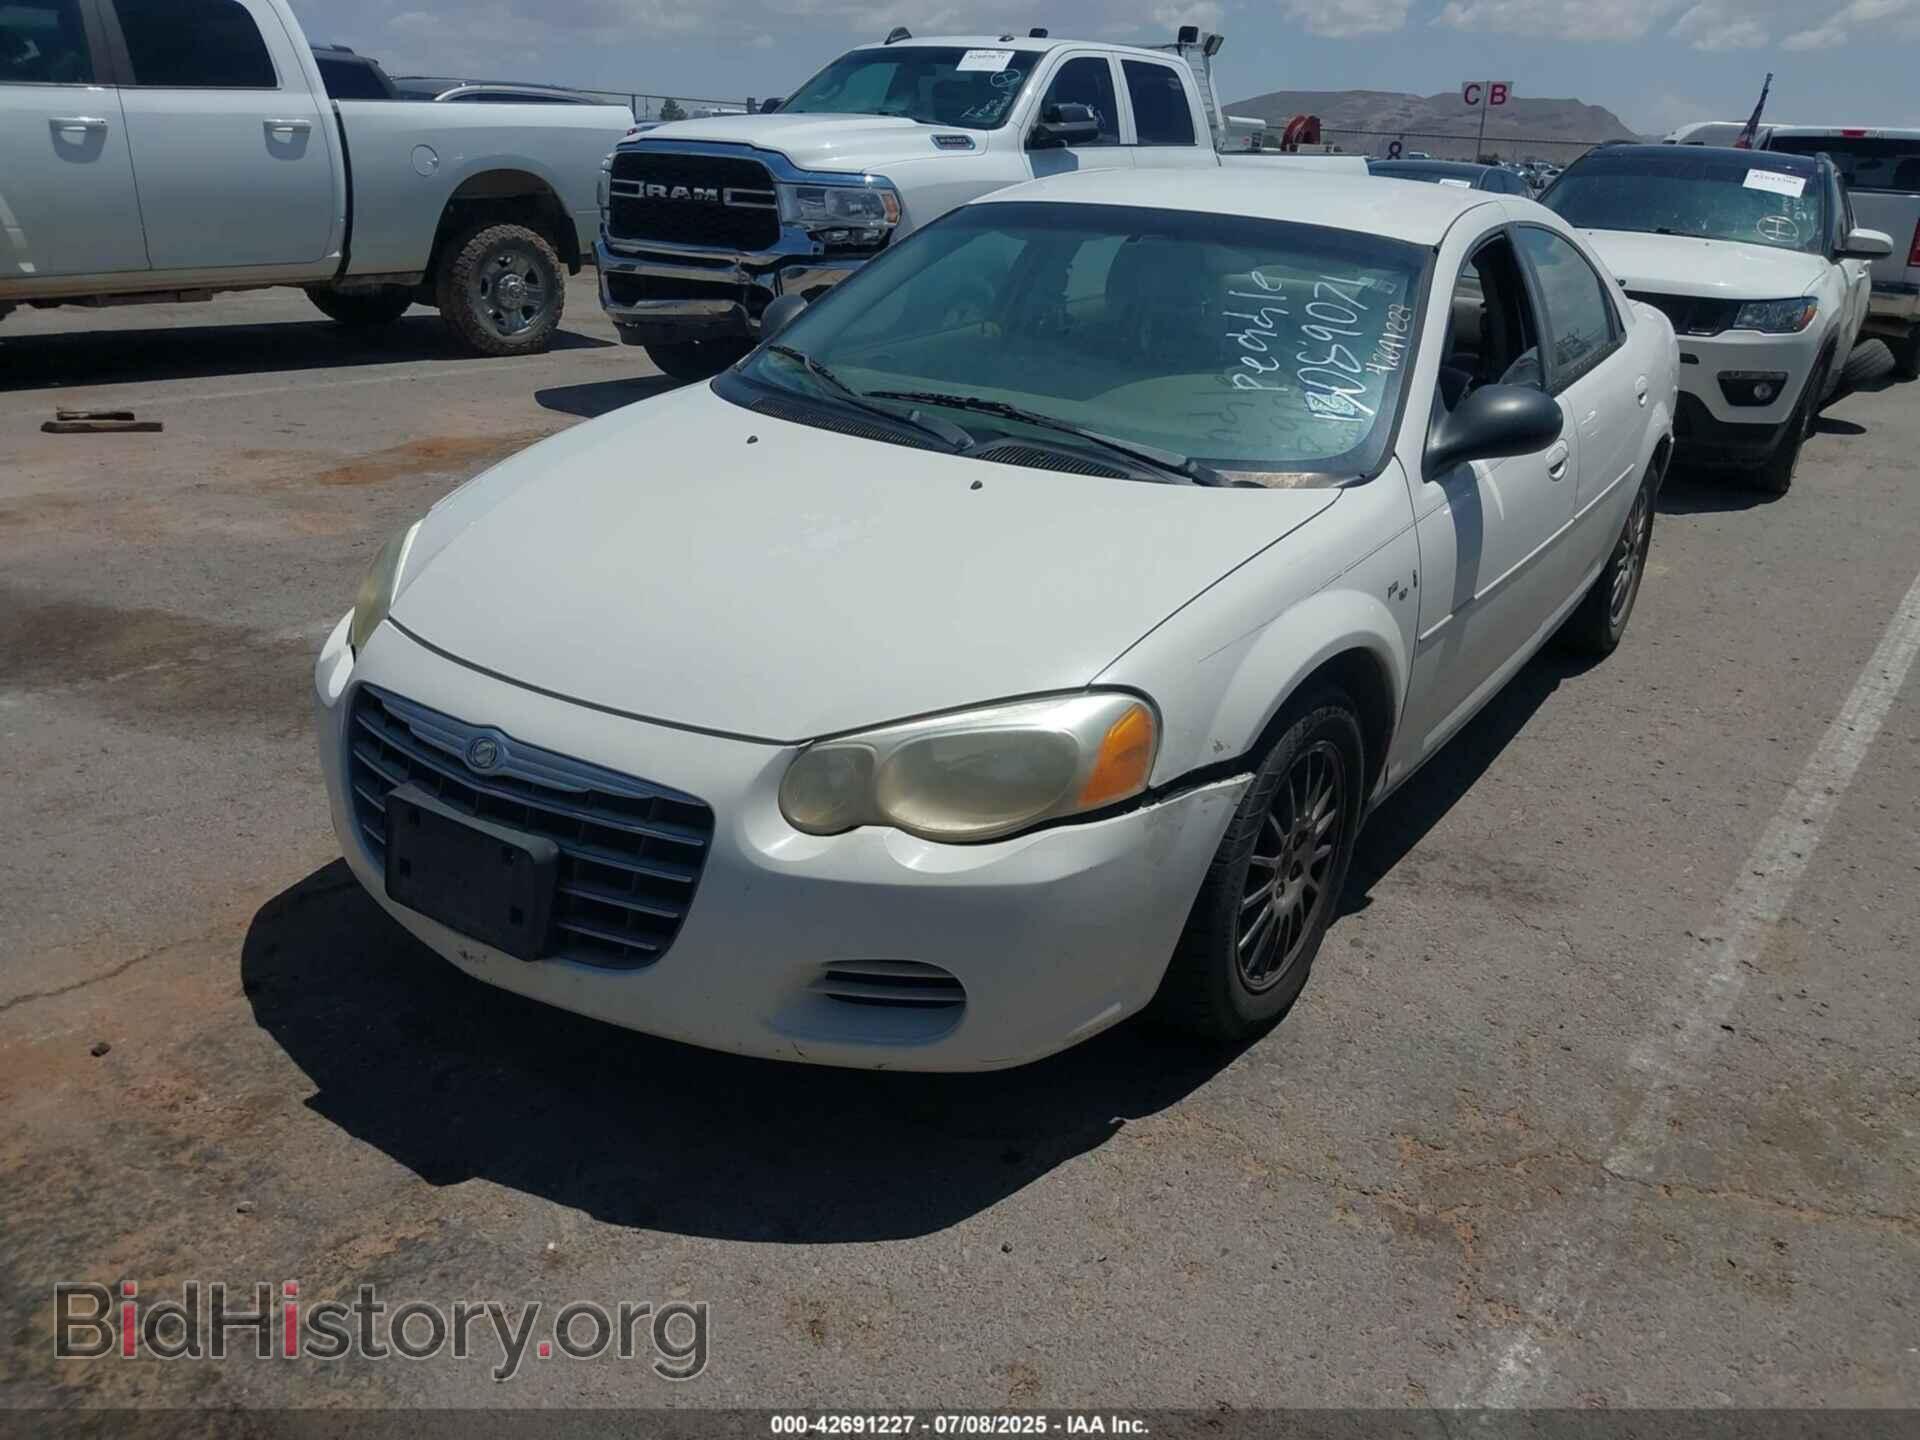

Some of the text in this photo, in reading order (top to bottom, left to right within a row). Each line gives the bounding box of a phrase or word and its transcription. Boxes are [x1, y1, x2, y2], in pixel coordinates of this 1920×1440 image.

[1464, 84, 1481, 105] C
[1490, 84, 1507, 105] B
[646, 184, 718, 201] RAM
